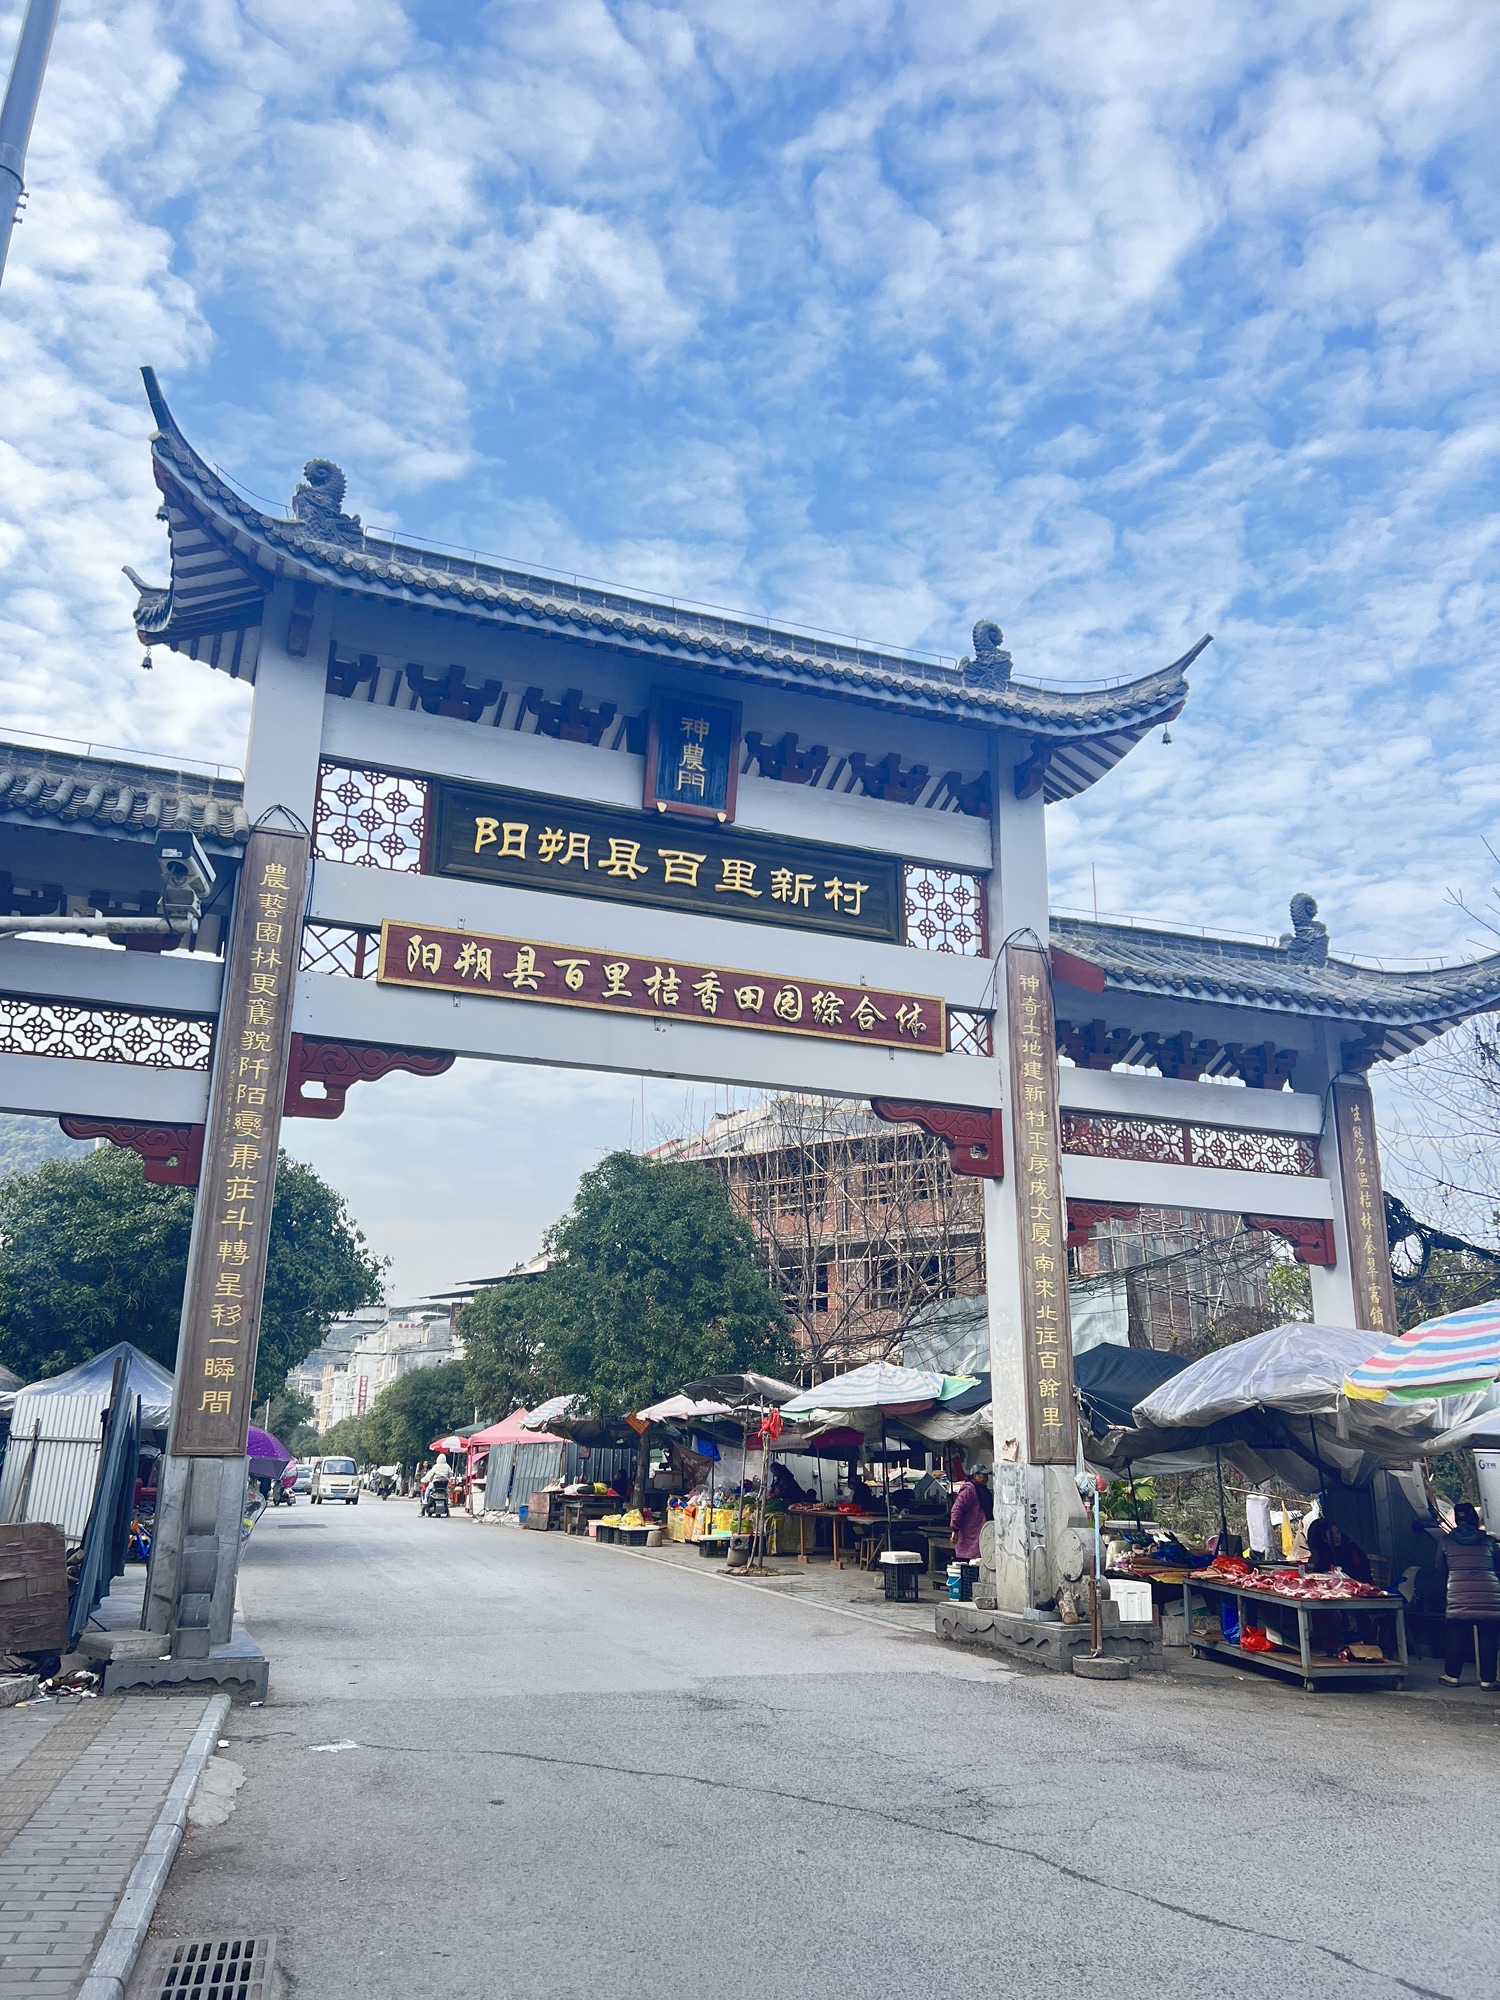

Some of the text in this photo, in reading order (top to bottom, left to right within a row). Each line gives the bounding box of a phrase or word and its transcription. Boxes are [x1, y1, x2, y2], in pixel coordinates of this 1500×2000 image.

[675, 717, 710, 797] 神農門
[474, 816, 870, 916] 阳朔县百里新村
[407, 934, 927, 1038] 阳朔县百里桔香田园综合体
